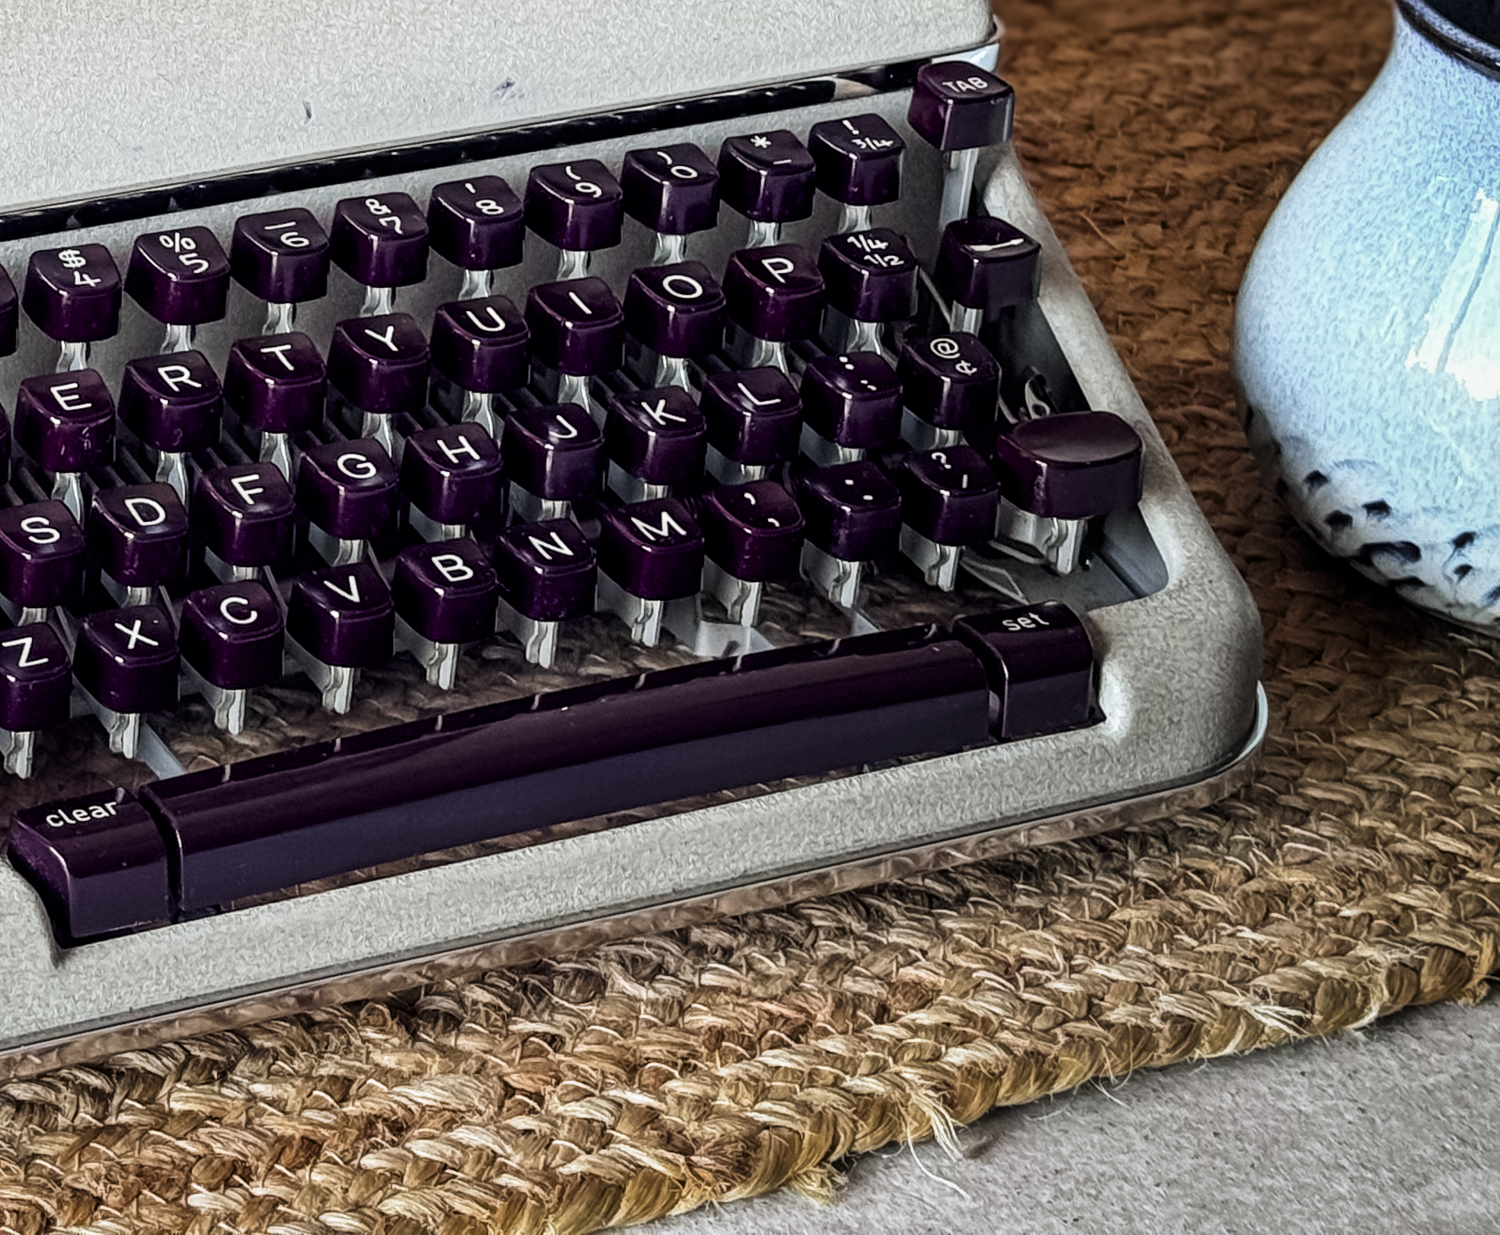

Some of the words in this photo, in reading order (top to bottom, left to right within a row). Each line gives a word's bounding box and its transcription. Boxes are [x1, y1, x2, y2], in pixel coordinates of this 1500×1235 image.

[942, 76, 990, 94] TAB
[59, 249, 86, 270] $
[159, 233, 196, 254] %
[73, 271, 102, 287] 4
[178, 254, 209, 273] 5
[280, 231, 310, 249] 6
[380, 217, 404, 234] 7
[475, 199, 504, 216] 8
[575, 181, 602, 198] 9
[670, 165, 698, 179] 0
[49, 383, 92, 411] E
[158, 364, 202, 391] R
[260, 344, 295, 371] T
[365, 326, 399, 352] Y
[466, 306, 506, 332] U
[568, 291, 592, 315] I
[662, 275, 702, 299] O
[761, 257, 795, 283] P
[21, 517, 61, 545] S
[124, 498, 166, 526] D
[230, 473, 264, 505] F
[337, 453, 377, 479] G
[437, 435, 480, 464] H
[548, 414, 578, 439] J
[641, 398, 686, 426] K
[737, 382, 781, 407] L
[930, 338, 960, 359] @
[2, 637, 49, 668] Z
[115, 619, 159, 650] X
[220, 597, 258, 625] C
[324, 576, 361, 603] V
[431, 554, 474, 582] B
[528, 532, 574, 560] N
[631, 511, 687, 541] M
[1002, 610, 1050, 632] set
[45, 799, 119, 829] clear
